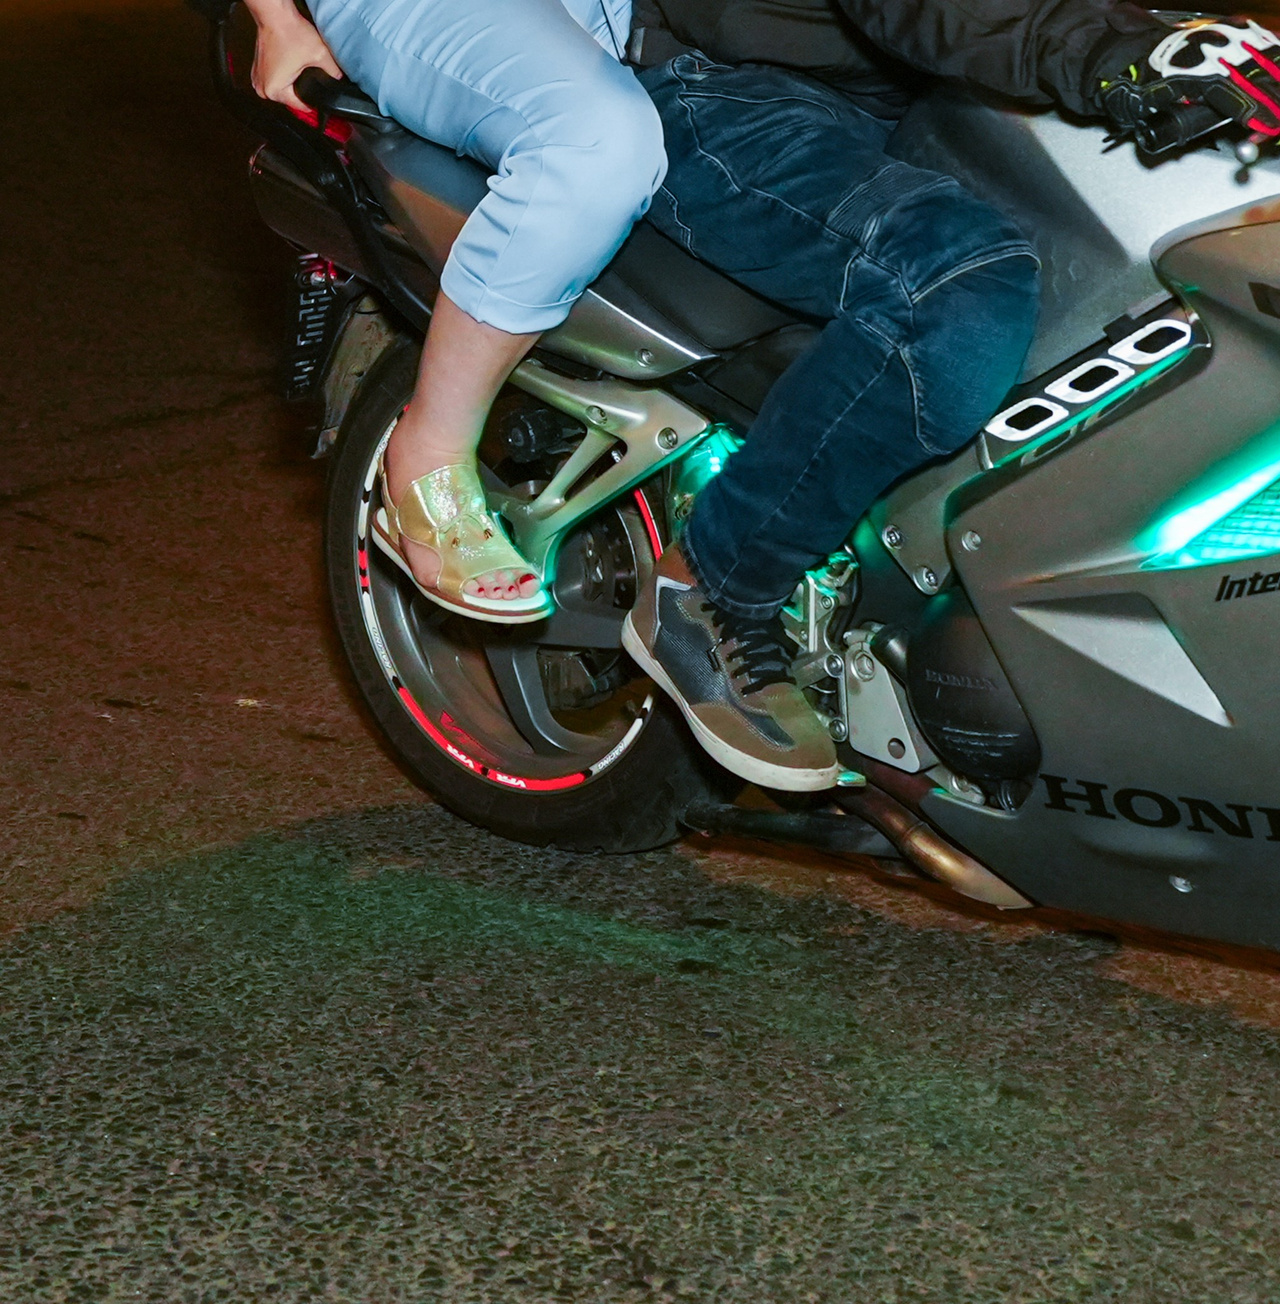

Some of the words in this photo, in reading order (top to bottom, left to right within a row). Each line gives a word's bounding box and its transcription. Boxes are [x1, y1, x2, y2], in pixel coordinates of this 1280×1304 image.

[447, 743, 475, 769] VFR
[597, 740, 626, 772] RACING
[496, 773, 528, 788] VFR
